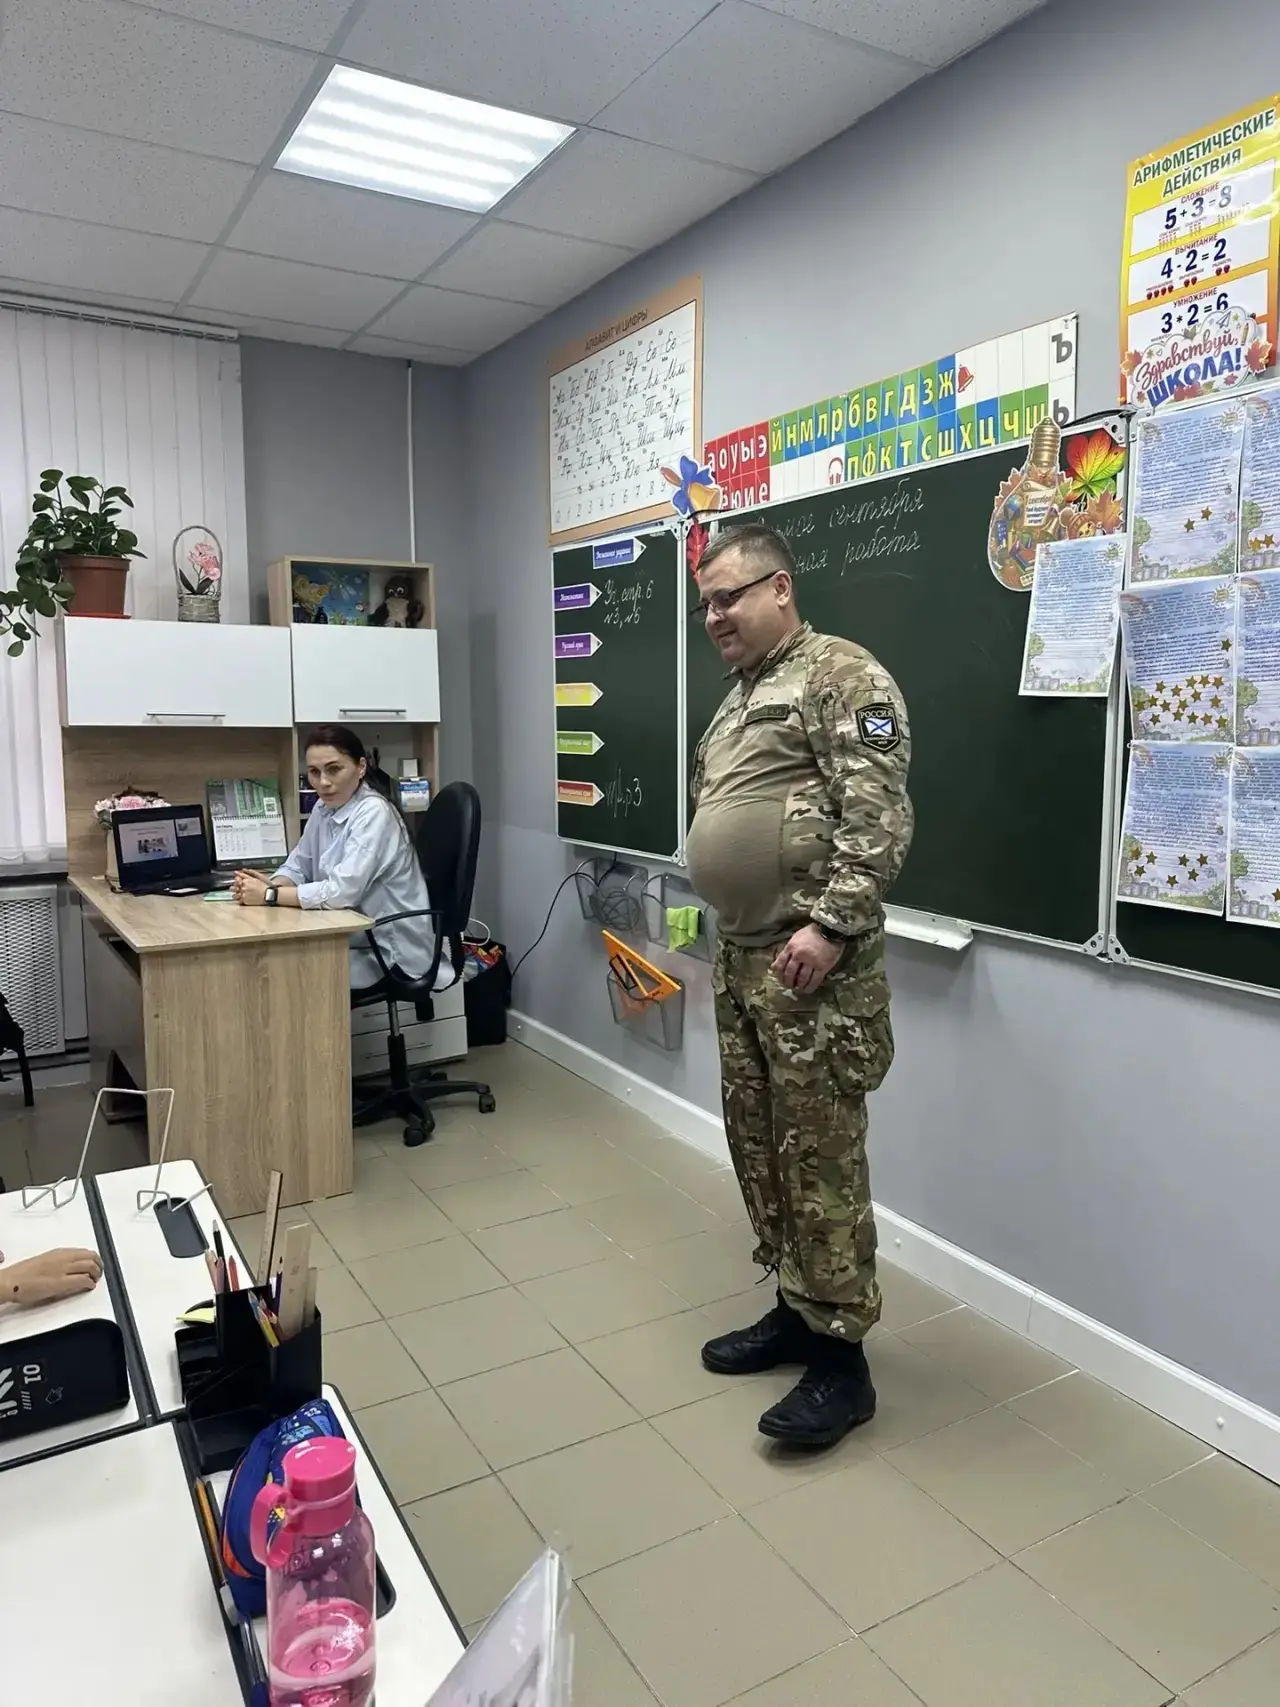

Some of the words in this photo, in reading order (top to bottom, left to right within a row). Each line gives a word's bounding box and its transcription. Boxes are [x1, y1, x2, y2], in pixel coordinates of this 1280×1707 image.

[1133, 108, 1276, 187] АРИФМЕТИЧЕСКИЕ
[1162, 148, 1242, 197] ДЕЙСТВИЯ
[1181, 182, 1220, 204] СЛОЖЕНИЕ
[1164, 208, 1177, 230] 5
[1191, 197, 1204, 218] 3
[1218, 185, 1232, 208] 8
[1161, 258, 1173, 279] 4
[1185, 249, 1198, 272] 2
[1214, 238, 1227, 261] 2
[1175, 233, 1218, 255] ВЫЧИТАНИЕ
[1161, 312, 1172, 334] 3
[1187, 304, 1199, 326] 2
[1216, 292, 1229, 310] 6
[1173, 287, 1218, 308] УМНОЖЕНИЕ
[622, 308, 648, 332] ЦИФРЫ
[1136, 329, 1238, 390] Здравствуй,
[1147, 348, 1242, 408] ШКОЛА!
[829, 478, 924, 530] сентября
[840, 526, 922, 576] работа
[860, 710, 893, 719] РОССИЯ
